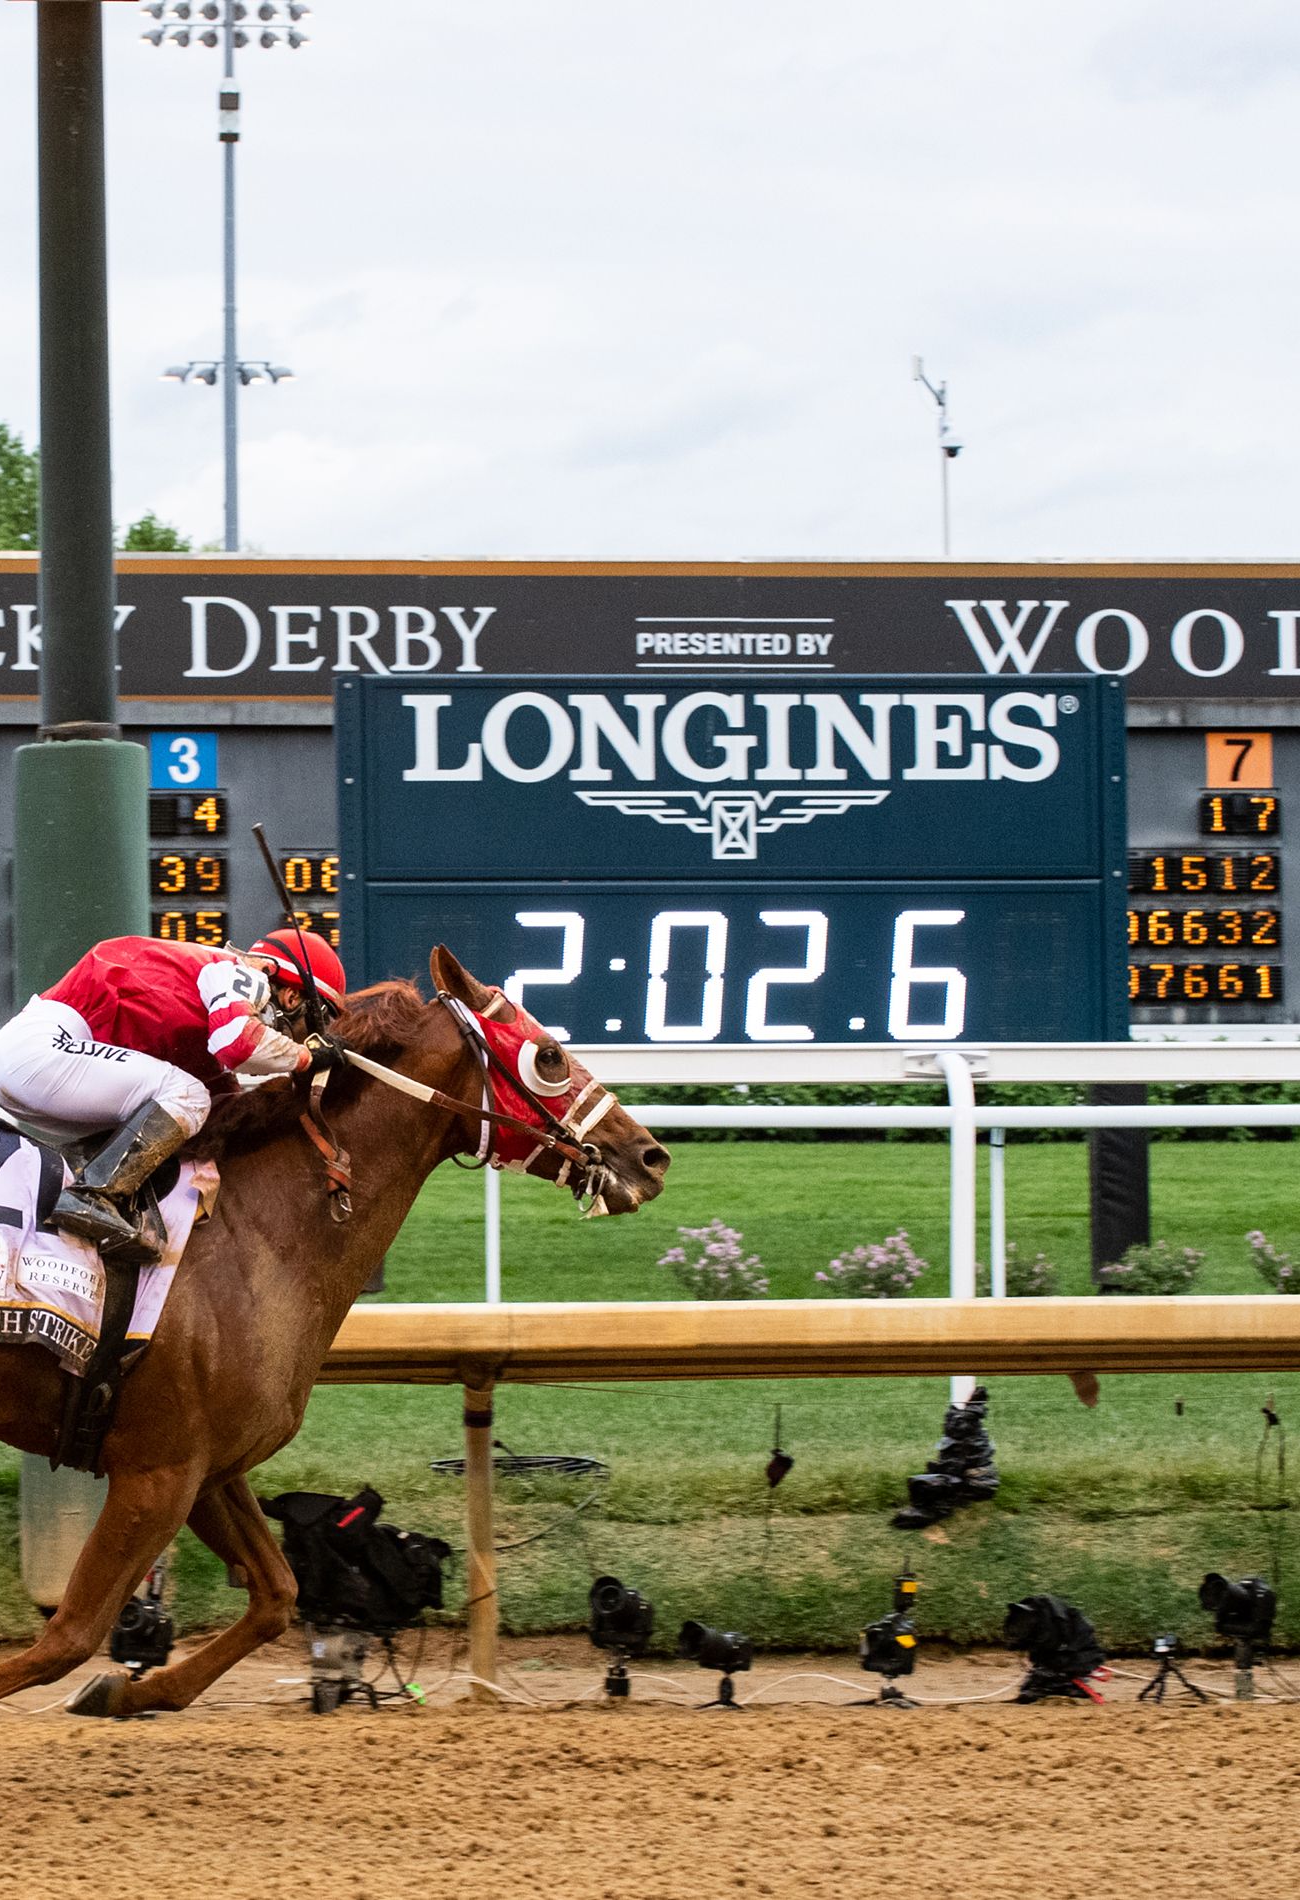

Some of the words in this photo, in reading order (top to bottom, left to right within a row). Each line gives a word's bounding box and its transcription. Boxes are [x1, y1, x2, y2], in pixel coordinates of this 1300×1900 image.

[182, 595, 498, 676] DERBY
[635, 632, 791, 655] PRESENTED
[795, 632, 834, 655] BY
[167, 737, 201, 784] 3
[401, 691, 1060, 784] LONGINES
[1225, 739, 1253, 782] 7
[194, 798, 221, 832] 4
[503, 910, 967, 1042] 2:02.6
[28, 1309, 98, 1362] STRIKE
